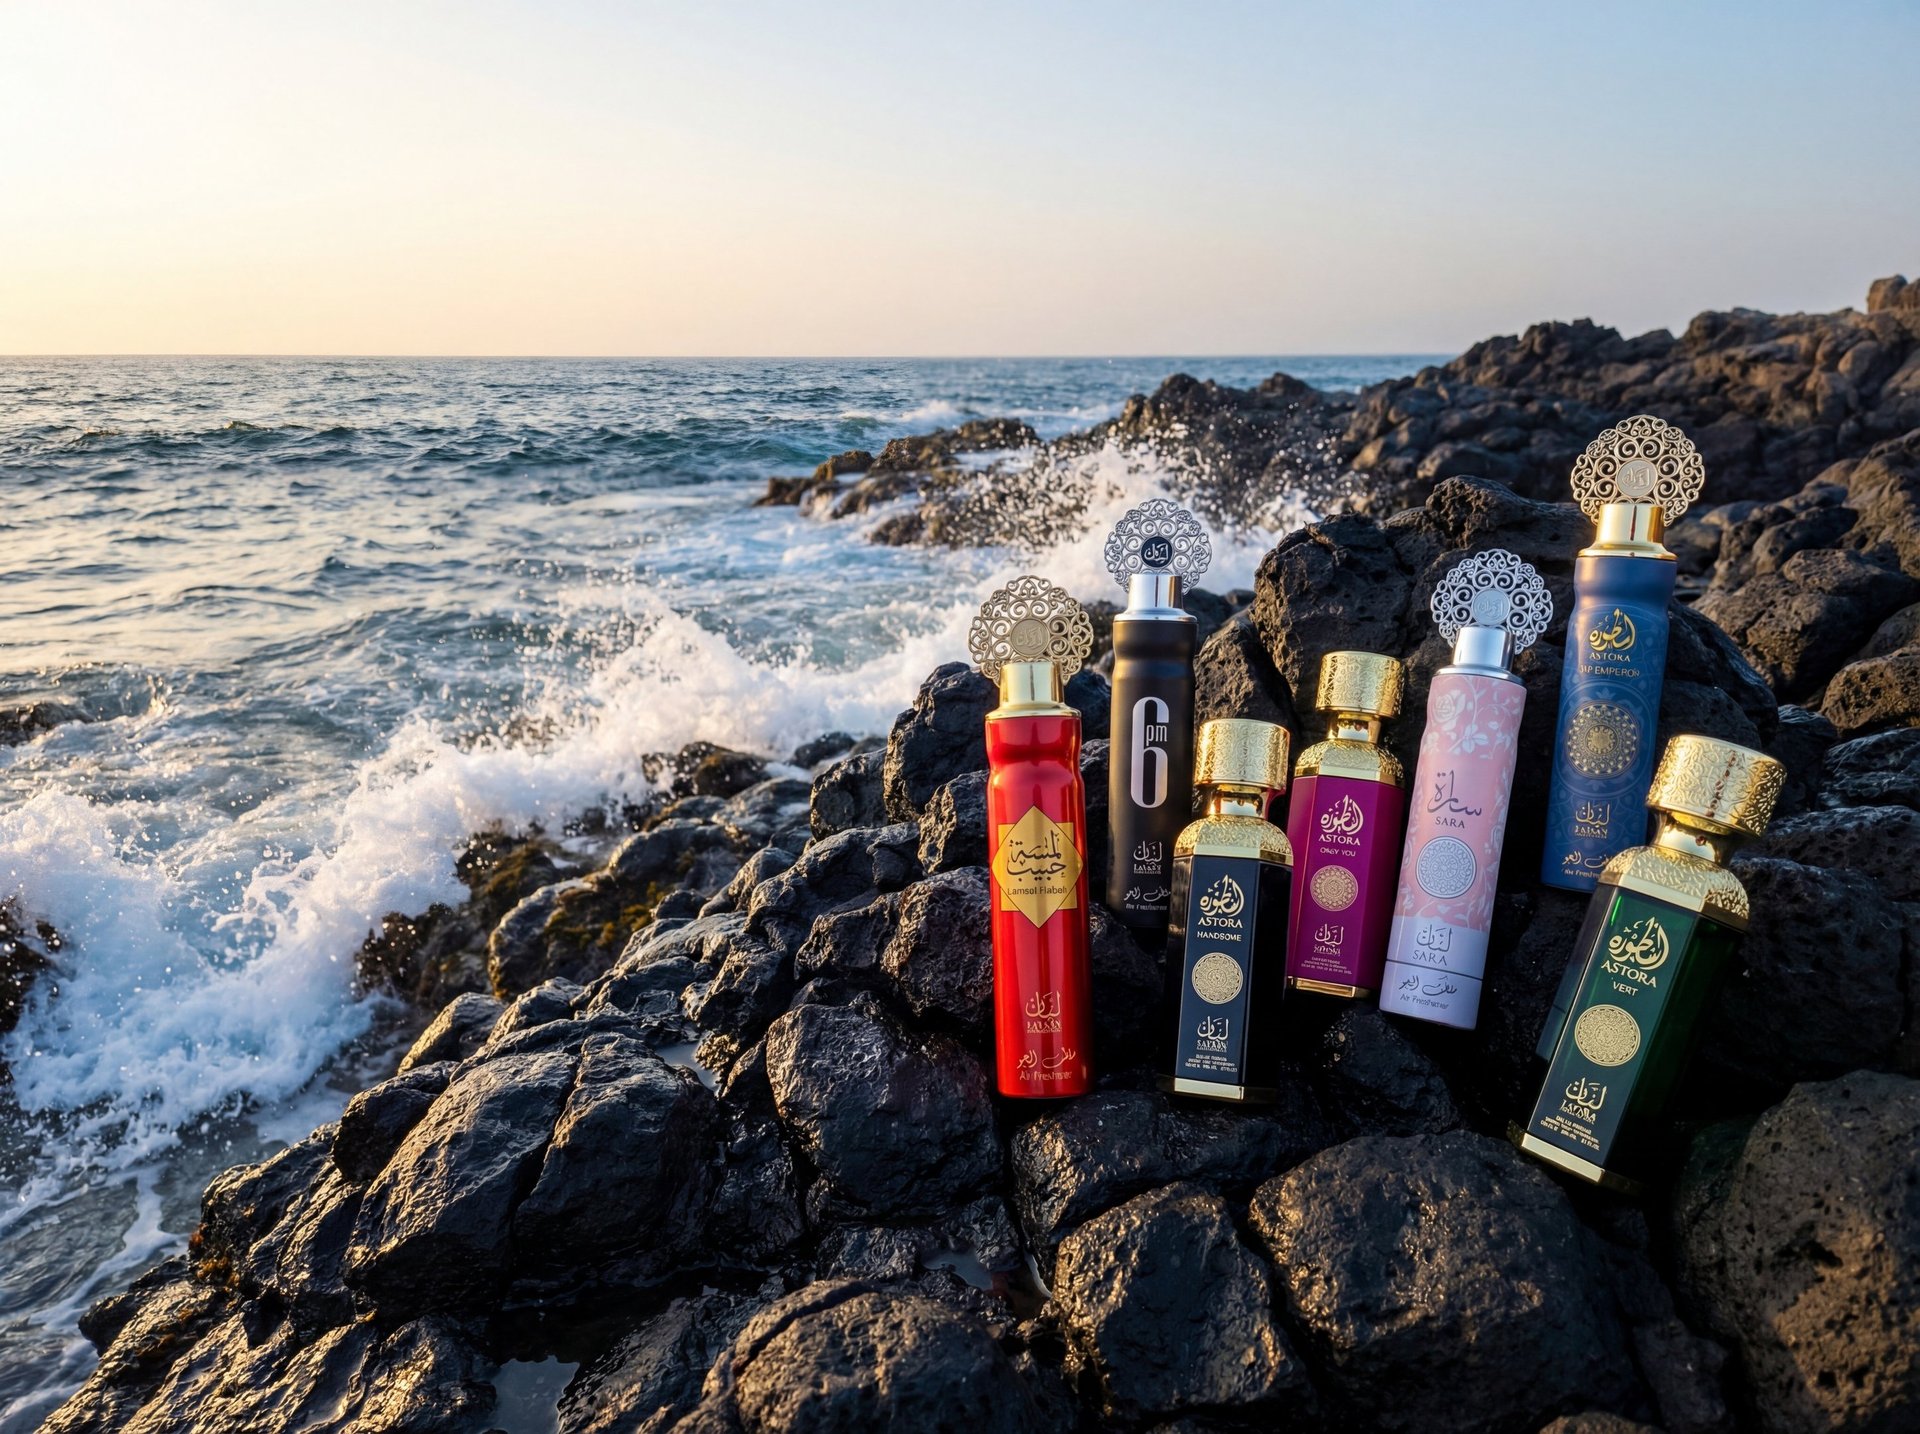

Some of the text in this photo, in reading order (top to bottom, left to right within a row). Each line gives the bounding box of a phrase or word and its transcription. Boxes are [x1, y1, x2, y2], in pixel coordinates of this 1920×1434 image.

[1146, 724, 1168, 747] pm
[1130, 696, 1170, 809] 6
[1435, 816, 1466, 829] SARA
[1318, 834, 1361, 846] ASTORA
[1341, 849, 1356, 857] YOU
[1197, 917, 1243, 928] ASTORA
[1197, 931, 1242, 941] HANDSOME
[1412, 949, 1447, 966] SARA
[1601, 959, 1657, 988] ASTORA
[1613, 981, 1638, 996] VERT
